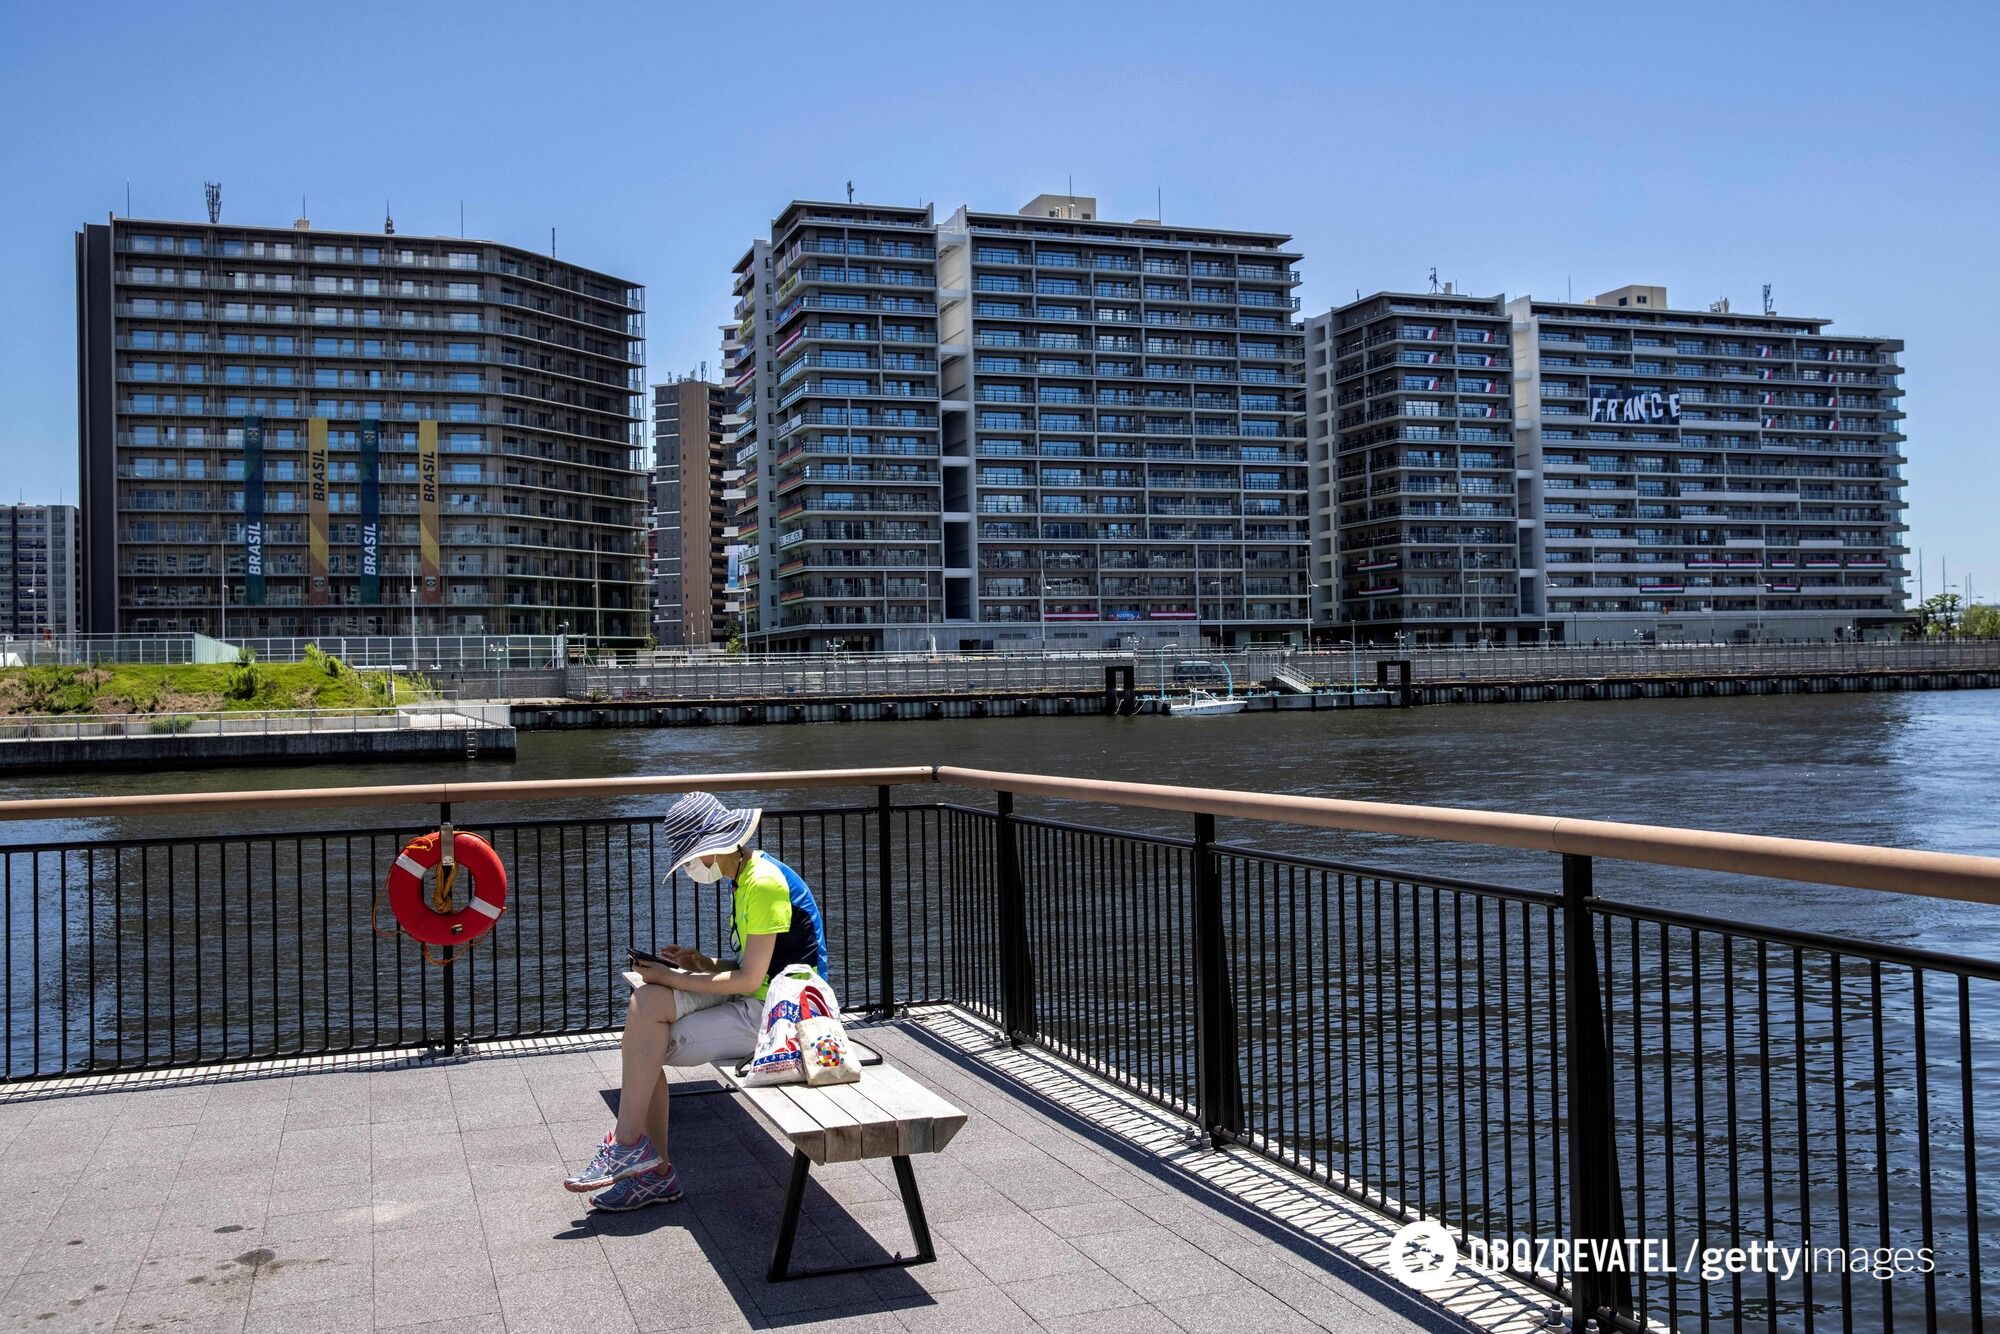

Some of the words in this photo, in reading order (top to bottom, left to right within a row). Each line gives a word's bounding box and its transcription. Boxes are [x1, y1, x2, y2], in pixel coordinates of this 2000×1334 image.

[1591, 393, 1680, 421] FRANCE
[313, 449, 325, 502] BRASIL
[423, 451, 435, 503] BRASIL
[248, 522, 261, 576] BRASIL
[364, 523, 376, 576] BRASIL
